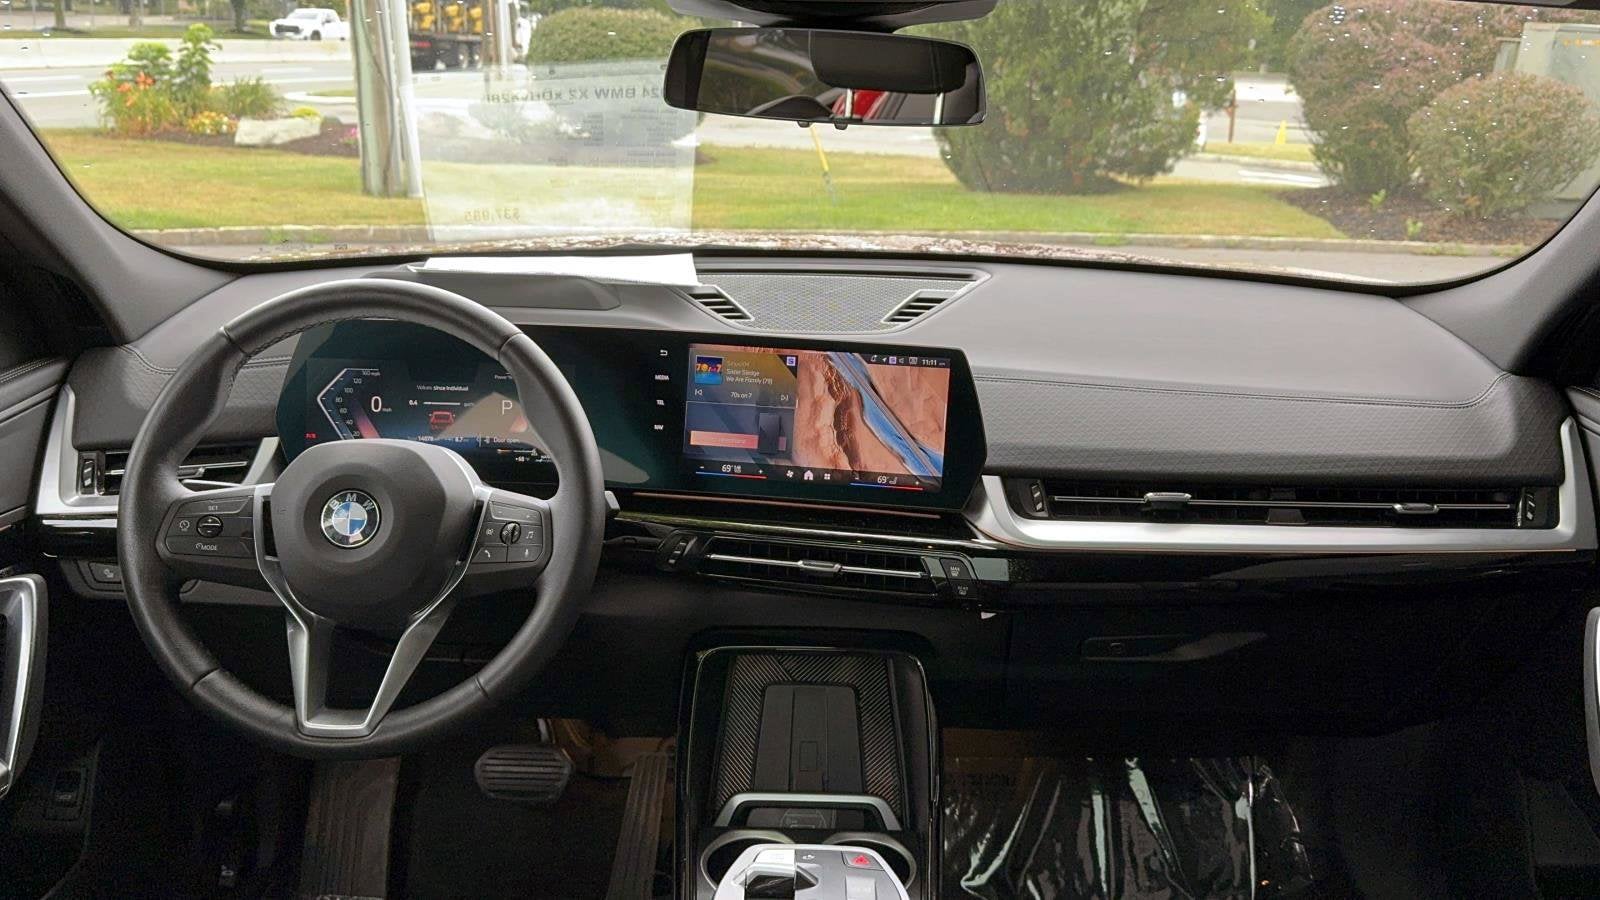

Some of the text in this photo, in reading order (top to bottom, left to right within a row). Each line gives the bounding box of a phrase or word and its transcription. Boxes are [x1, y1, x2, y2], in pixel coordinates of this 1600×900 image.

[371, 395, 382, 412] 0
[502, 400, 513, 415] P
[329, 493, 375, 510] BMW
